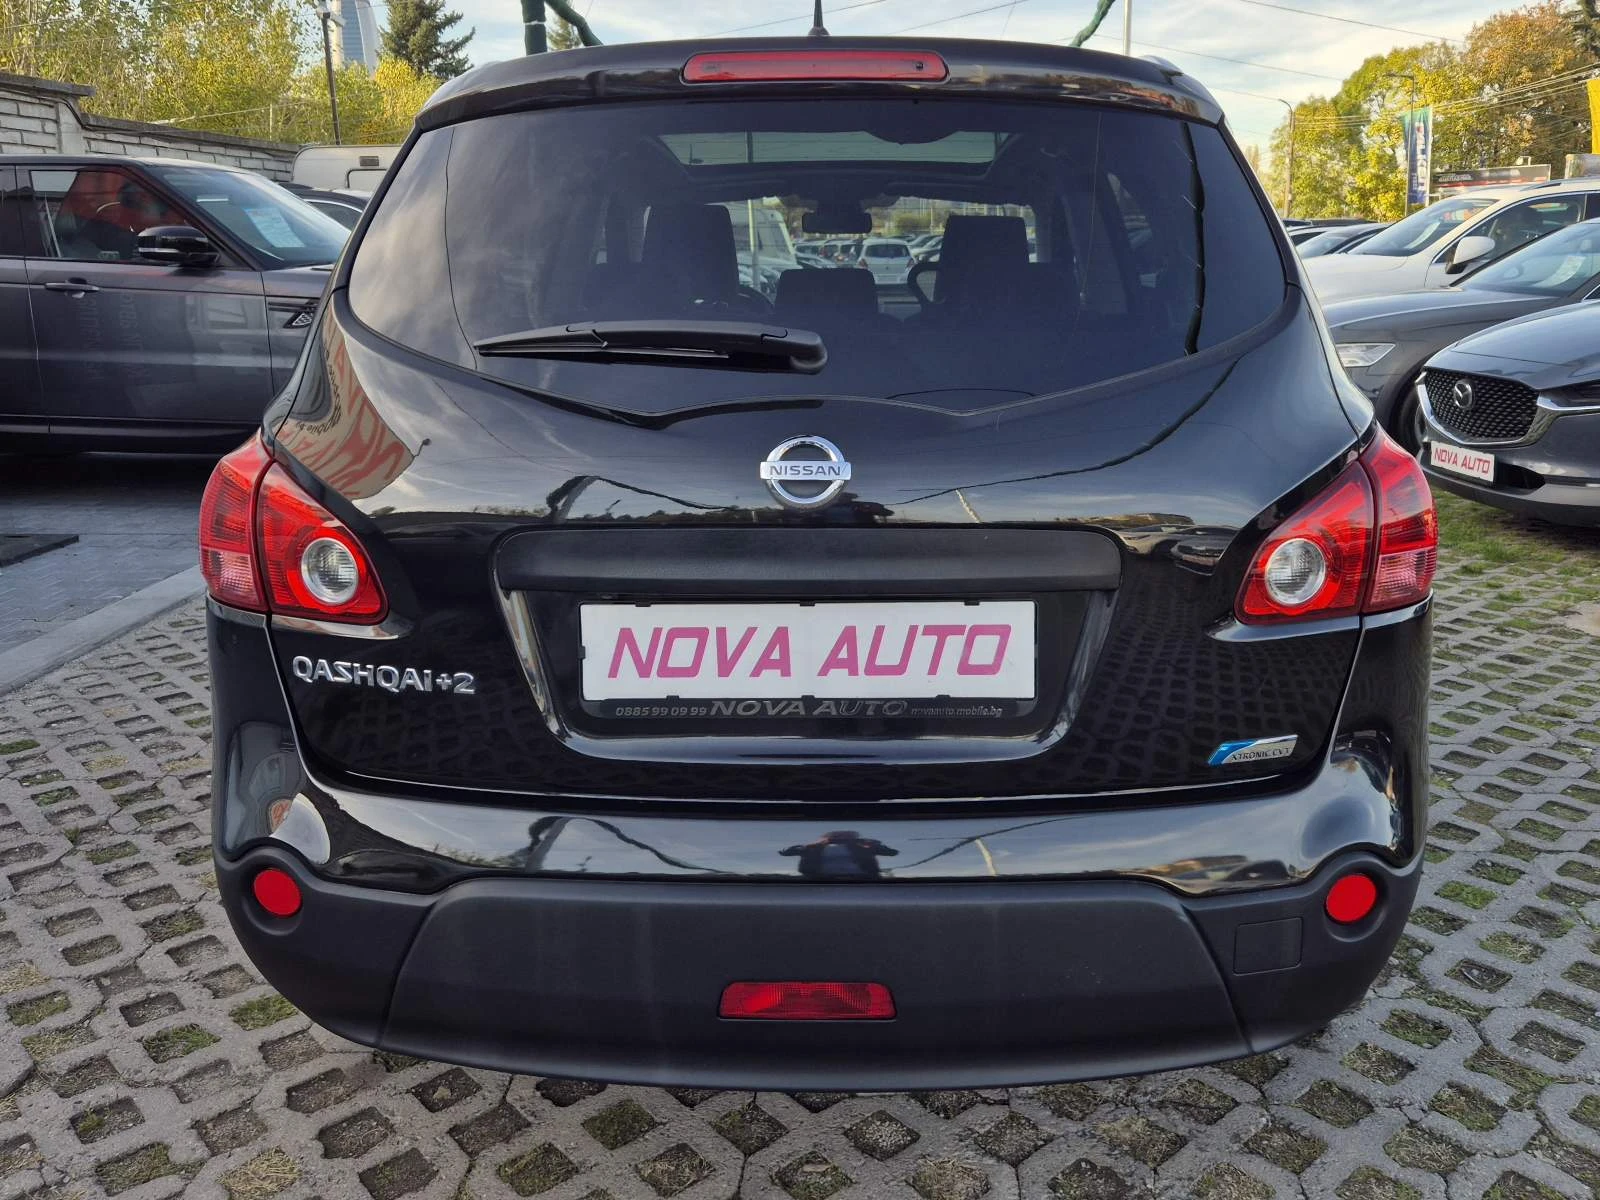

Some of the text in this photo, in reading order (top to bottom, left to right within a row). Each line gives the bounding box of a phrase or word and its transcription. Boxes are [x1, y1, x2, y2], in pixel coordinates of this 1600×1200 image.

[770, 465, 841, 476] NISSAN
[1434, 447, 1491, 474] NOVA AUTO
[608, 624, 1012, 678] NOVA AUTO
[615, 706, 649, 717] 0885
[652, 706, 669, 717] 99
[671, 706, 688, 717] 09
[690, 706, 708, 717] 99
[710, 700, 806, 716] NOVA
[813, 700, 908, 716] AUTO
